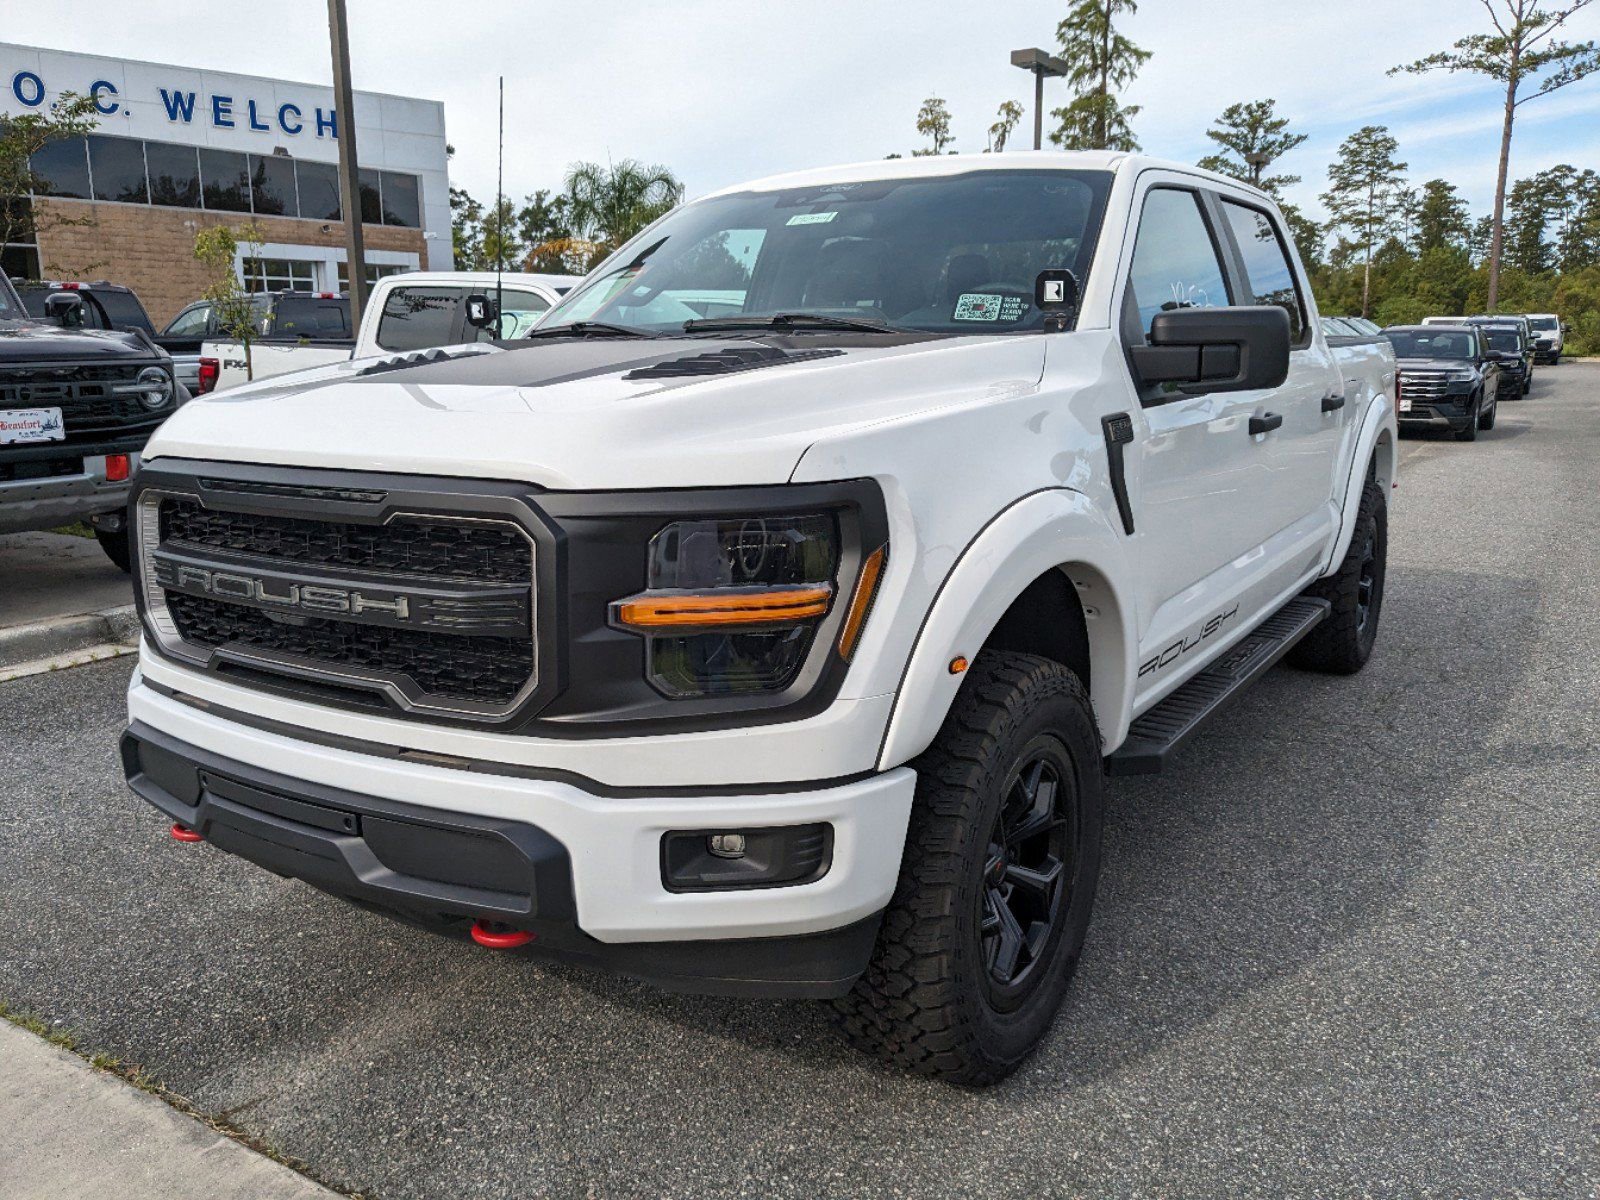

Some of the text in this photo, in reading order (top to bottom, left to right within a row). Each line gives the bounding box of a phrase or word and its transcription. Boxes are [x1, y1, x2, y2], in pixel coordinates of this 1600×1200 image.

[12, 70, 339, 139] O. C. WELCH
[178, 565, 410, 621] ROUSH
[1136, 601, 1240, 680] ROUSH
